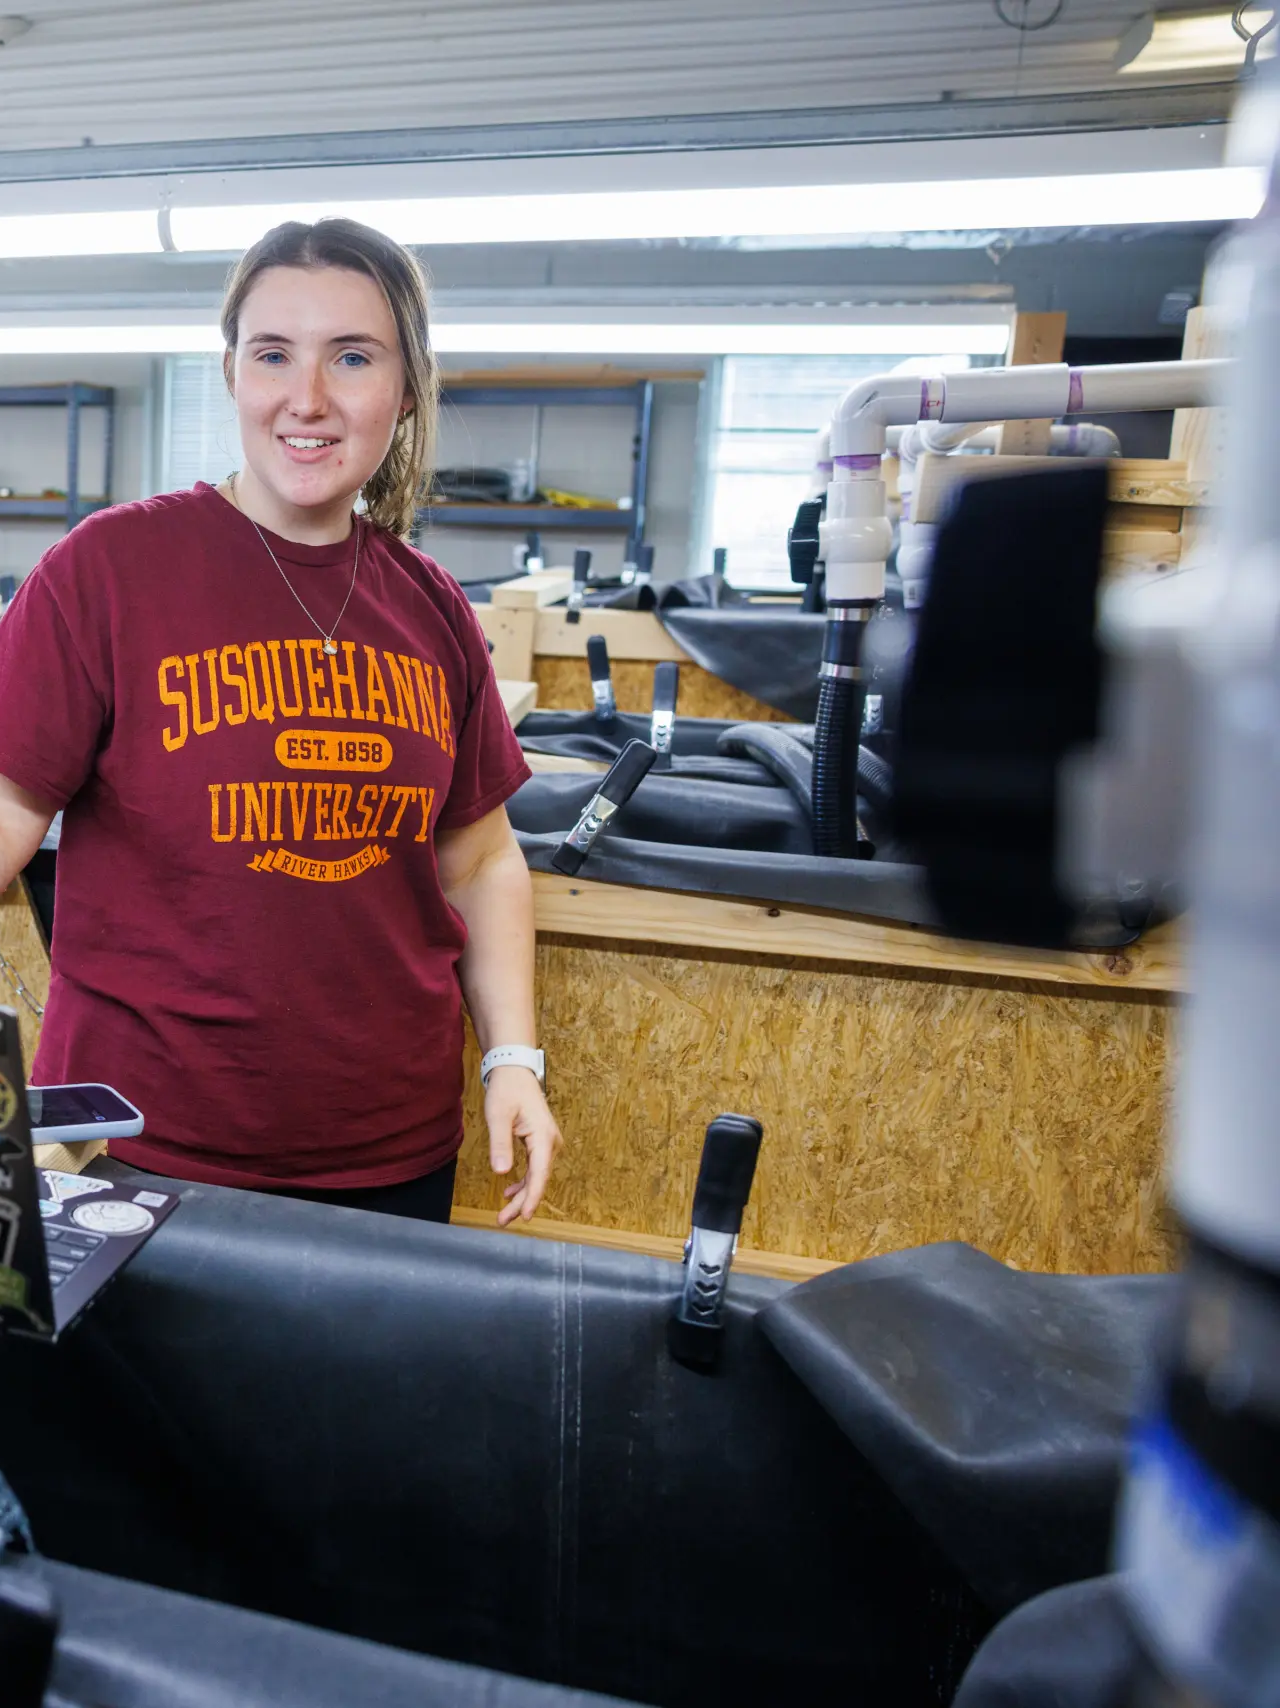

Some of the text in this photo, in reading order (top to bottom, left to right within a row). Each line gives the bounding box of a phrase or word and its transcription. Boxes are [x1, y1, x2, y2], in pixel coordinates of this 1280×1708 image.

[157, 638, 458, 760] SUSQUEHANNA
[286, 738, 384, 764] EST. 1858
[208, 781, 435, 843] UNIVERSITY
[280, 851, 372, 879] RIVER HAWKS
